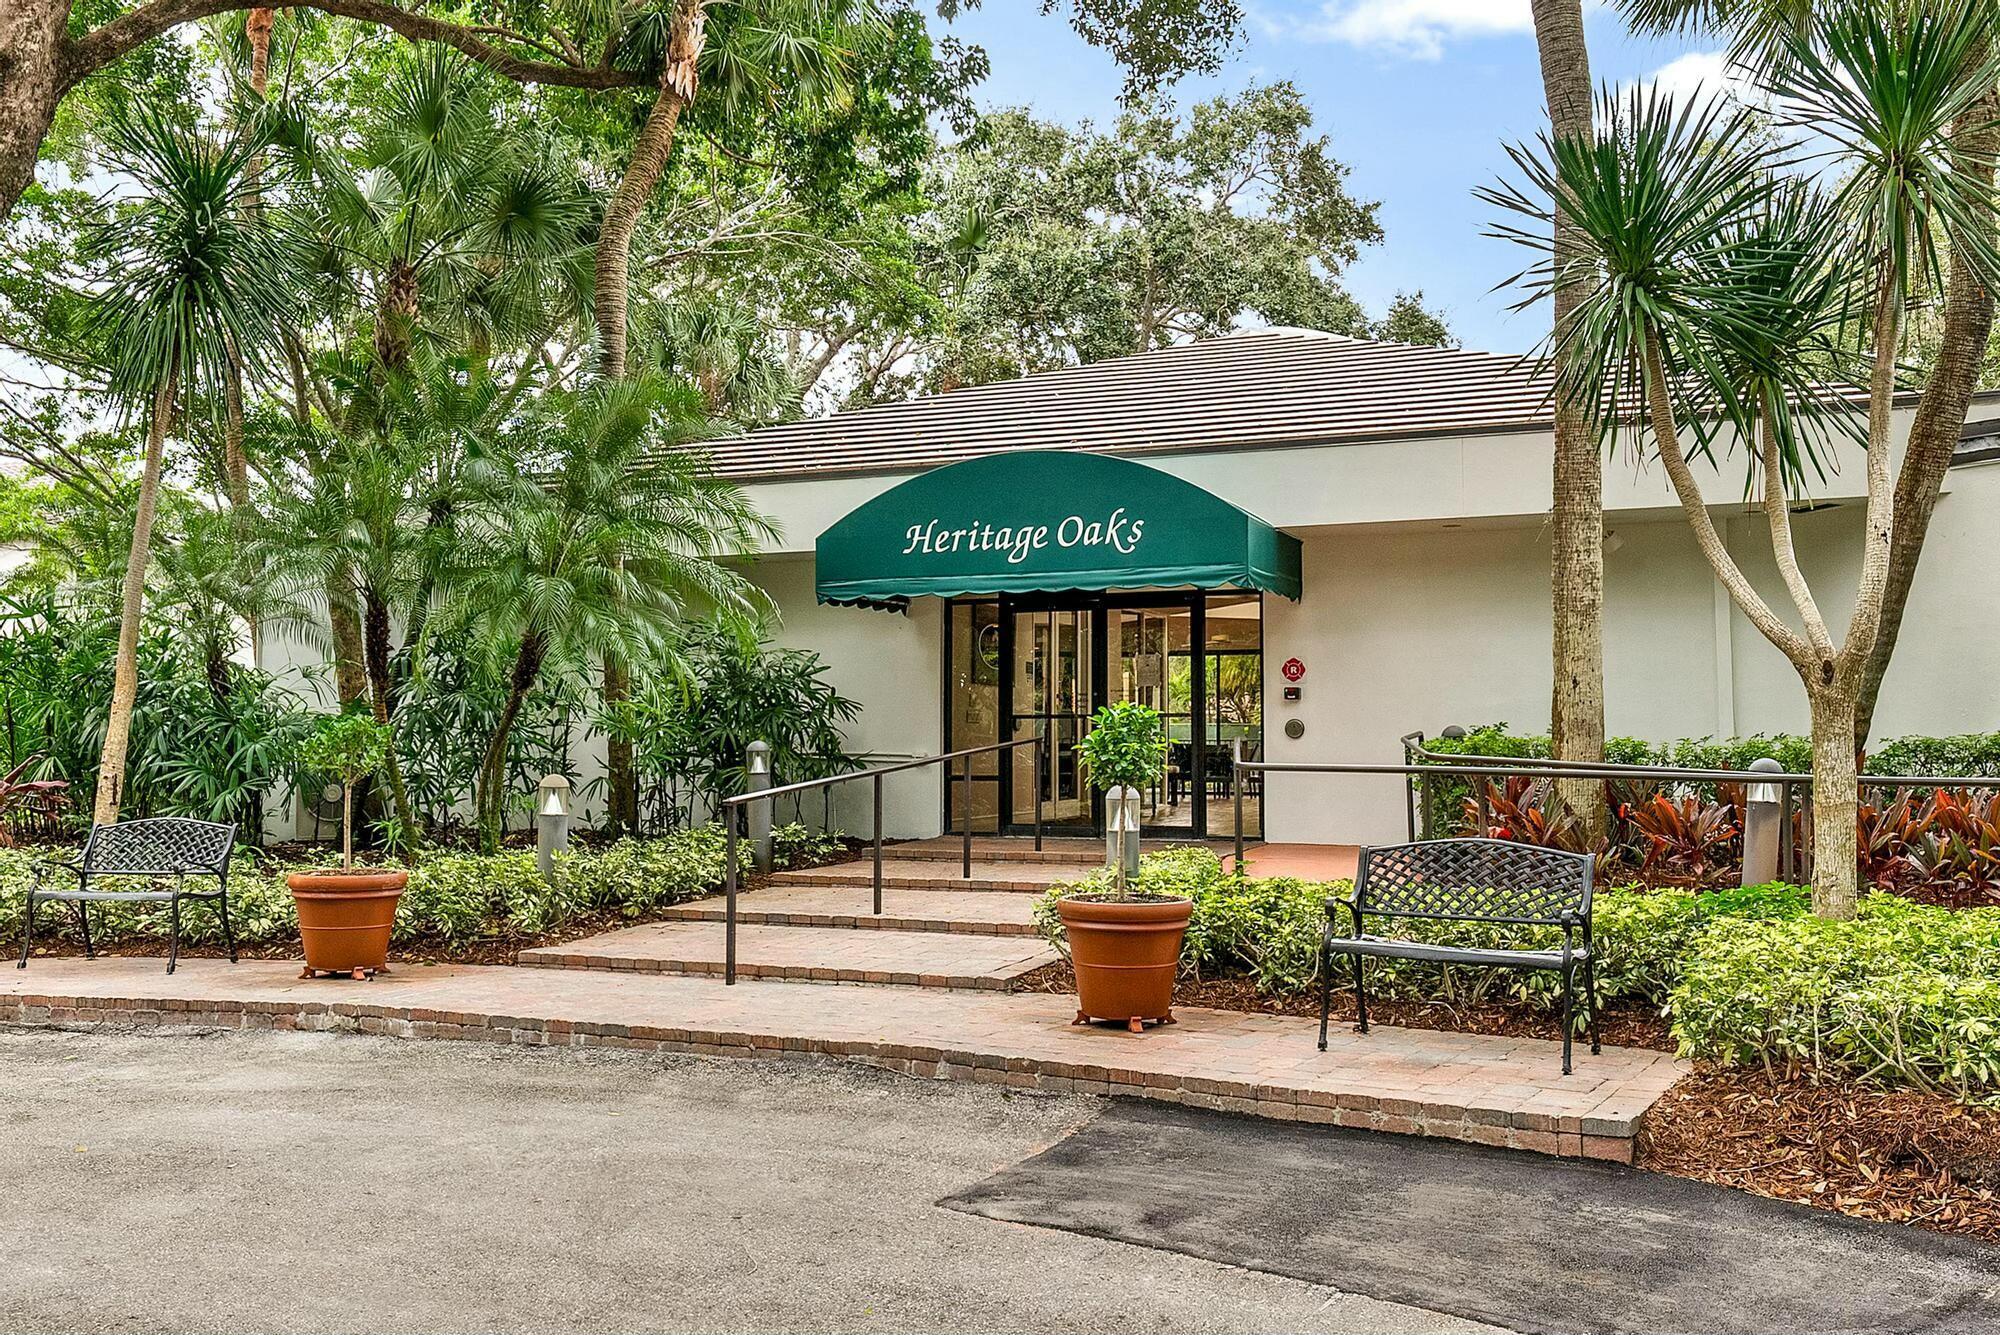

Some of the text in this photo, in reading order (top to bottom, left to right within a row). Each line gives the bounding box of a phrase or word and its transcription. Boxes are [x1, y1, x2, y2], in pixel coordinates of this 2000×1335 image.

[902, 507, 1145, 564] Heritage Oaks
[1290, 666, 1298, 674] R
